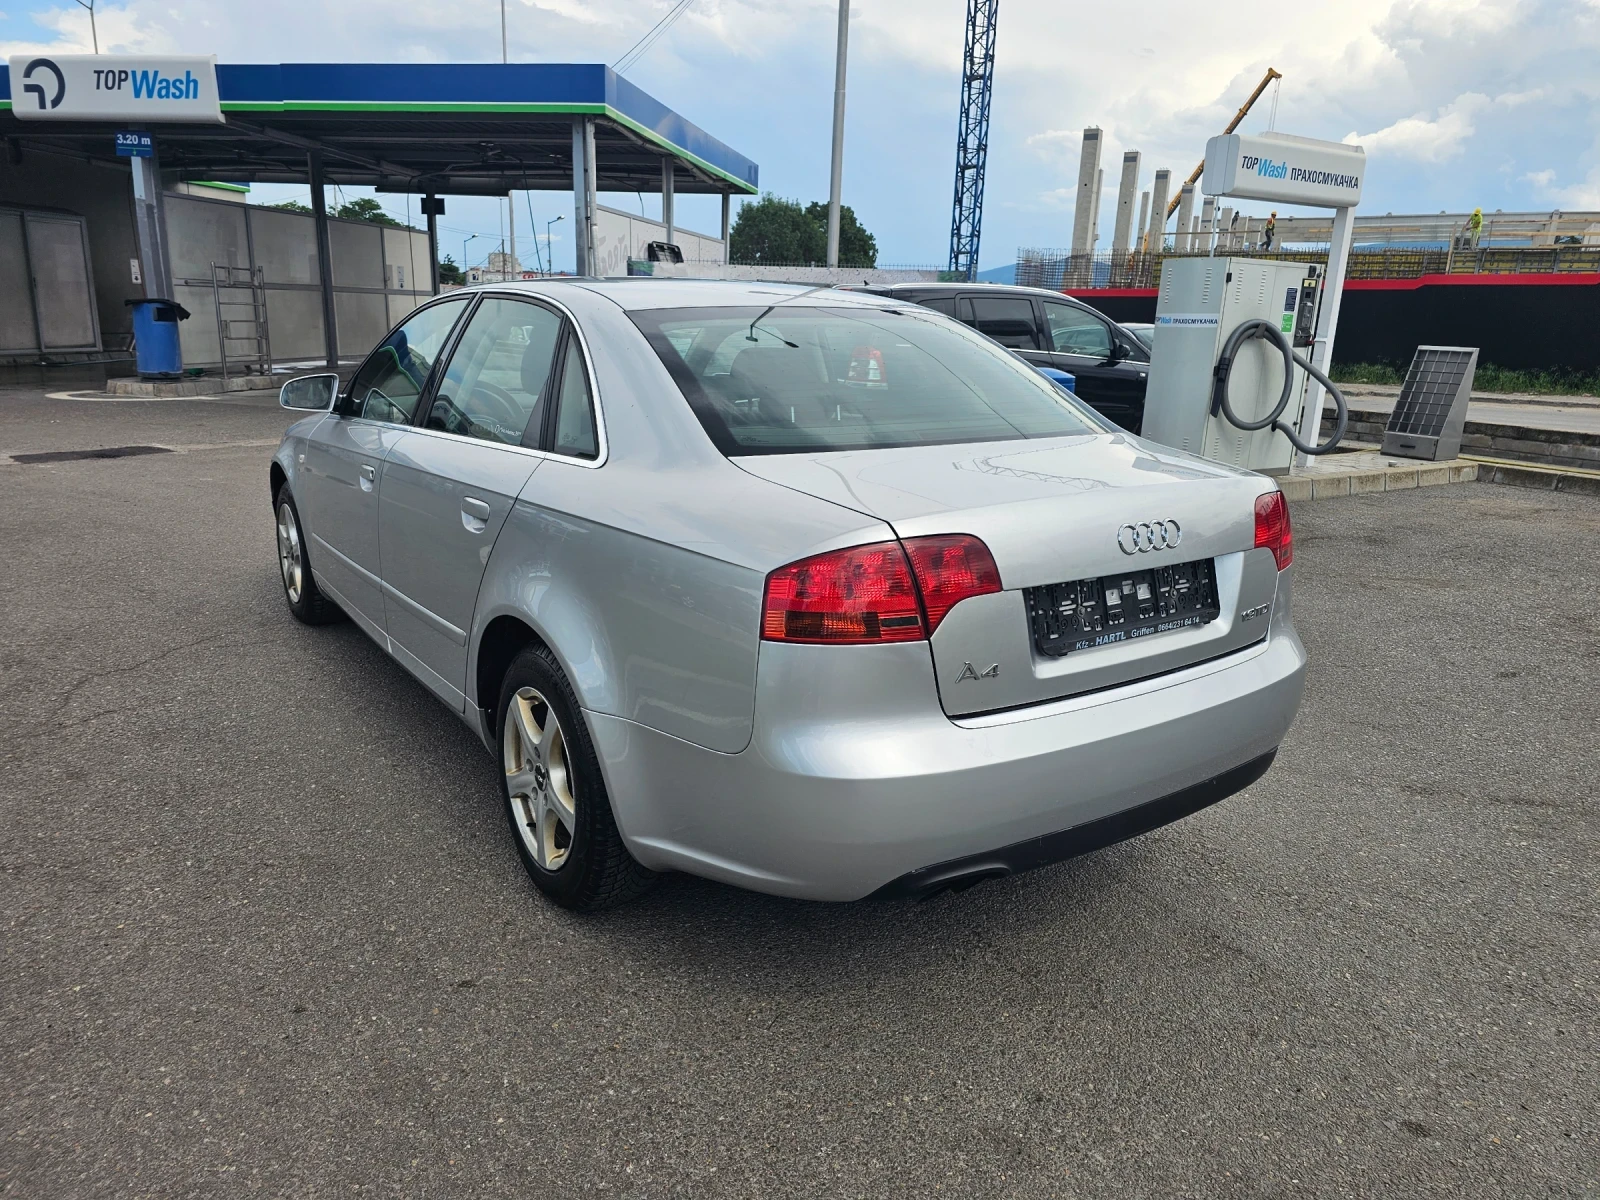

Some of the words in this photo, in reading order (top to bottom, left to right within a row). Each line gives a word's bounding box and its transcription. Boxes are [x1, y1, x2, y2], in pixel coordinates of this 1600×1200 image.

[116, 133, 139, 145] 3.20
[141, 137, 151, 145] m
[1290, 167, 1359, 189] ПРАХОСМУКАЧКА
[1076, 640, 1089, 650] Kfz
[1095, 631, 1127, 646] HARTL
[1131, 627, 1155, 638] Griffen
[954, 661, 1000, 684] A4
